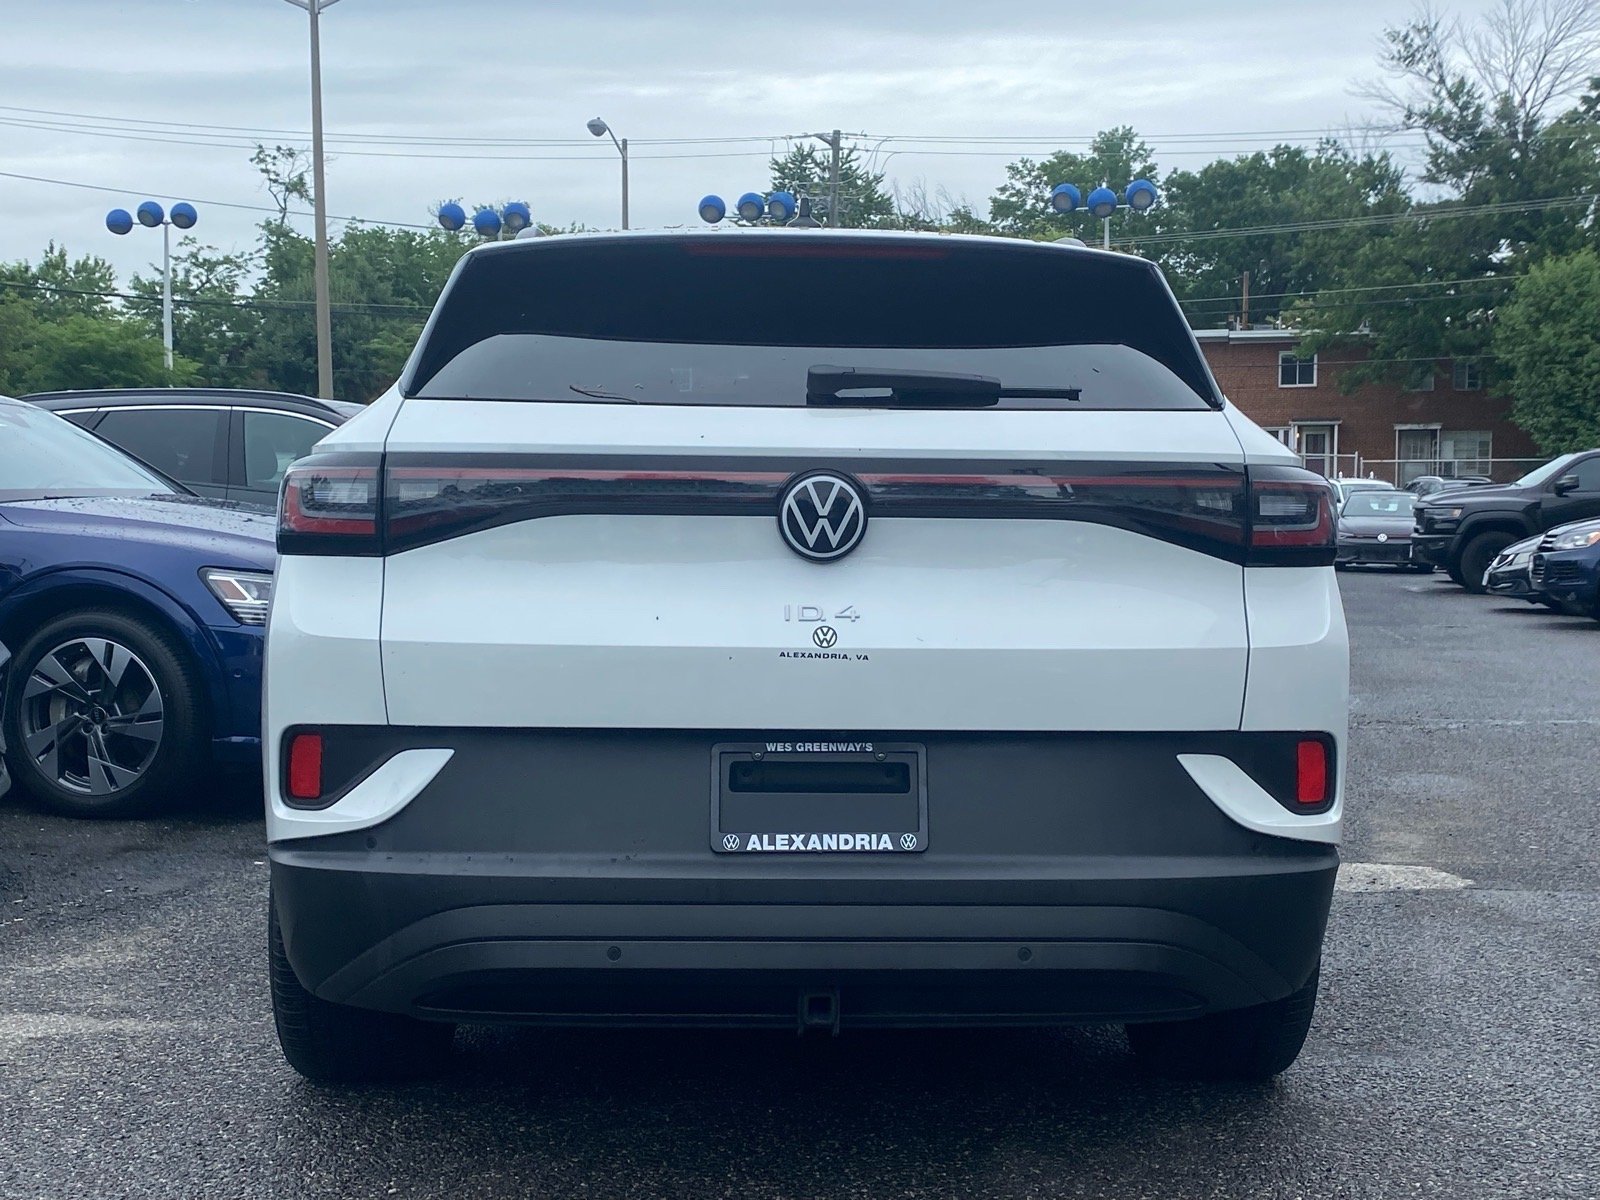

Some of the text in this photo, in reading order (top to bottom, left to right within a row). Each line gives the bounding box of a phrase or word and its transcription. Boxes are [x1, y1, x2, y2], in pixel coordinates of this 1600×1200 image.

[786, 478, 861, 553] VW
[813, 626, 837, 648] VW
[779, 651, 852, 661] ALEXANDRIA,
[766, 743, 873, 752] WES GREENWAY'S
[723, 833, 917, 850] VW ALEXANDRIA VW
